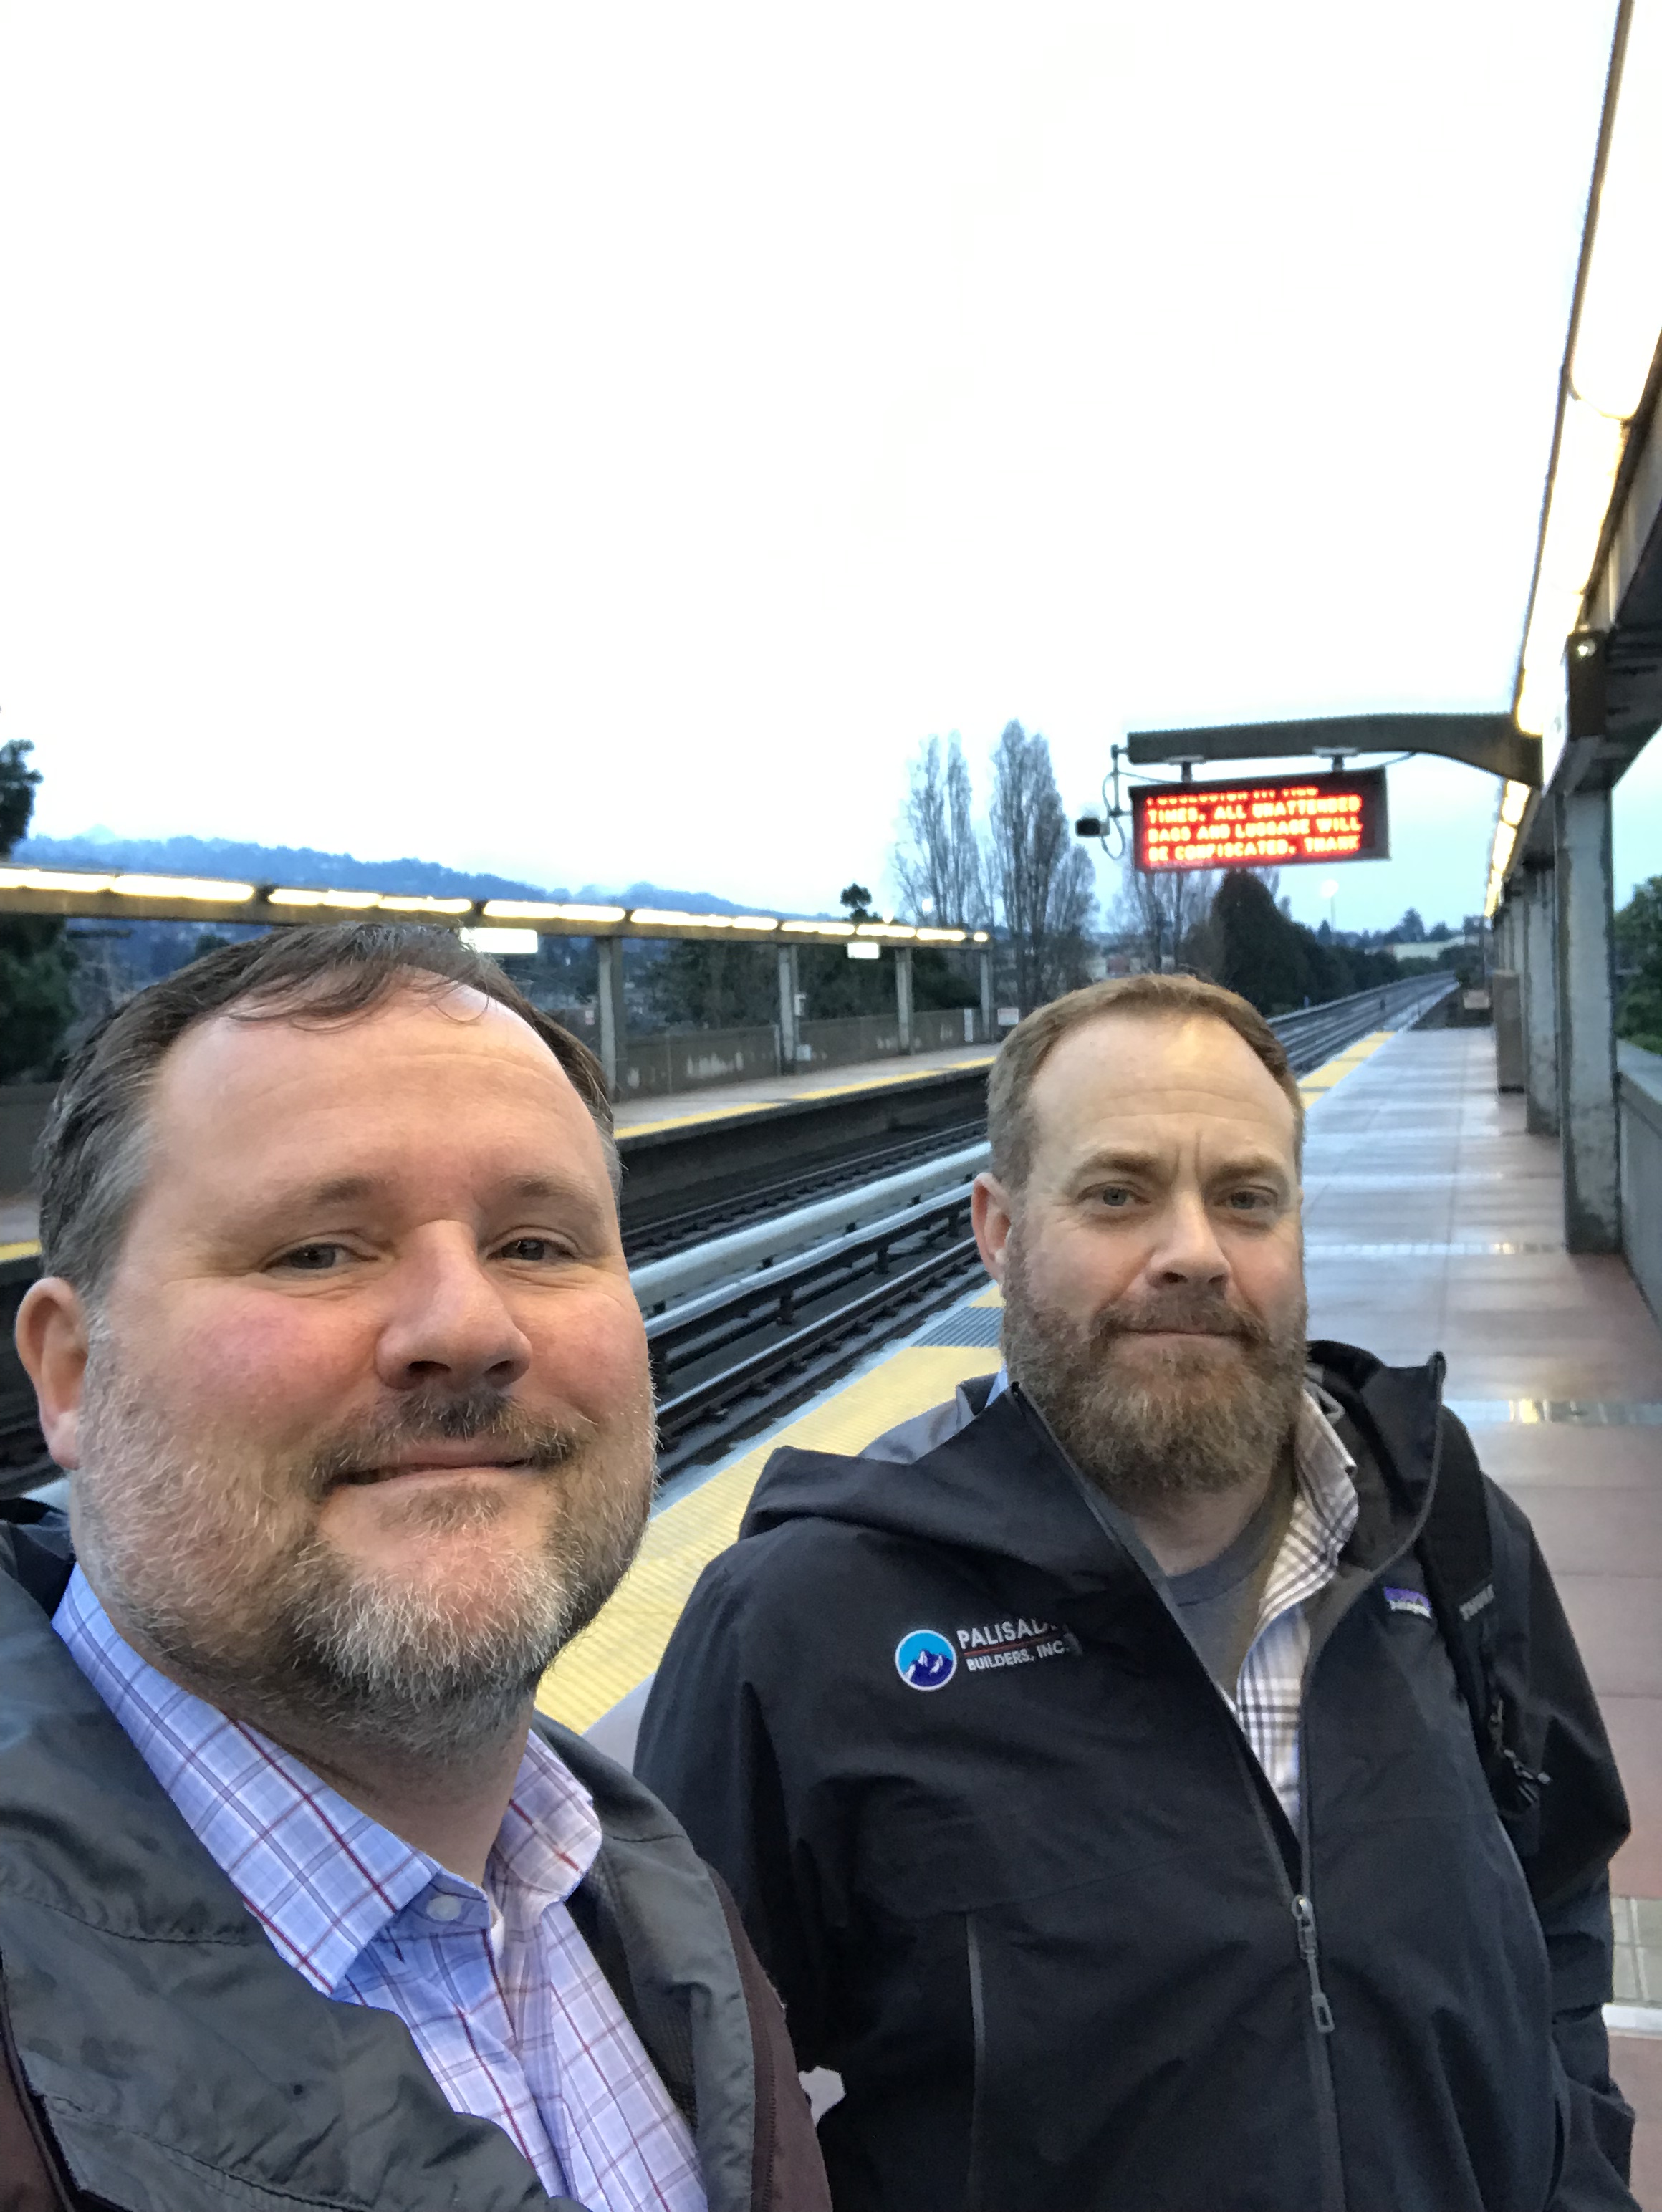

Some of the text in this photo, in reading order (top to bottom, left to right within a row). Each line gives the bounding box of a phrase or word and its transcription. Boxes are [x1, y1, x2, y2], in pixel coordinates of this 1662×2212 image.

[1148, 807, 1206, 824] TIMES.
[1214, 804, 1246, 820] ALL
[1252, 795, 1362, 819] UNATTENDED
[1148, 816, 1363, 843] BAGS AND LUGGAGE WILL
[1148, 845, 1169, 862] BE
[1304, 835, 1360, 852] THANK
[956, 1617, 1059, 1650] PALISAD
[966, 1648, 1035, 1672] BUILDERS,
